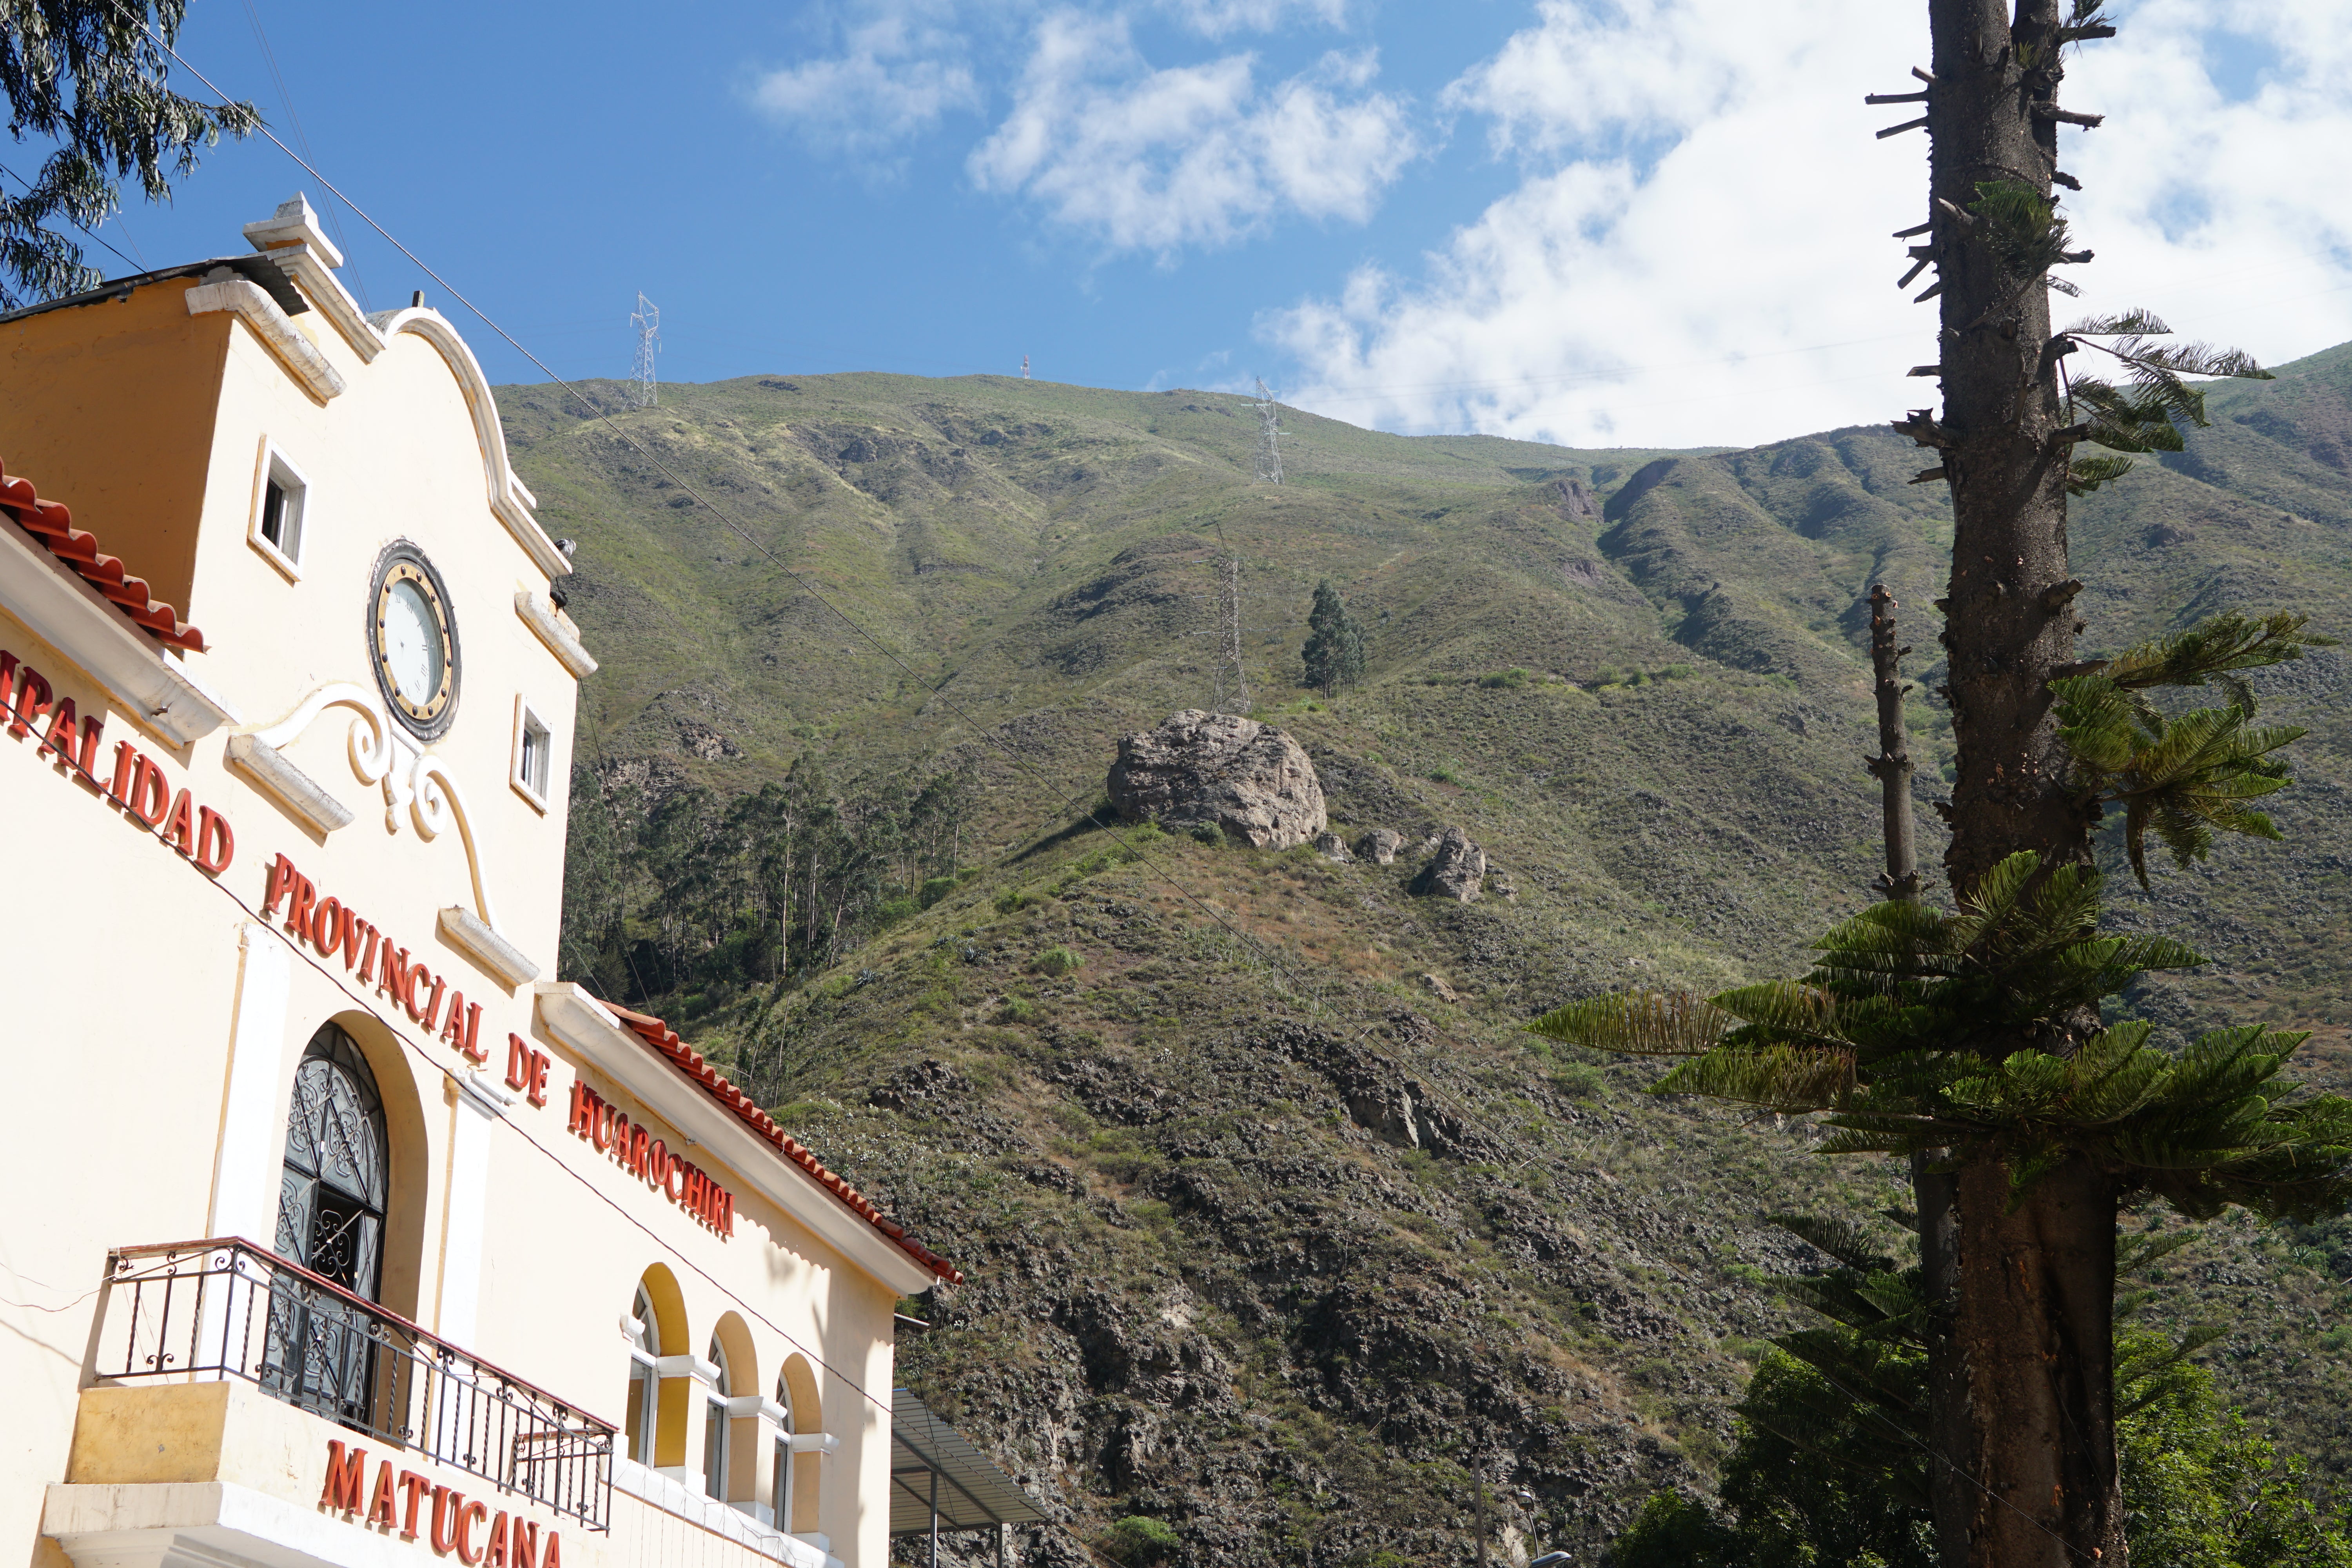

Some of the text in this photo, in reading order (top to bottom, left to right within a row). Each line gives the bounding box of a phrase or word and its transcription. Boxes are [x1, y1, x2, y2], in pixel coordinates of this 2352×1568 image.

[395, 592, 401, 604] XI
[405, 598, 414, 614] XII
[0, 650, 736, 1238] IPALIDAD PROVINCIAL DE HUAROCHIRI
[318, 1439, 561, 1568] MATUCANA
